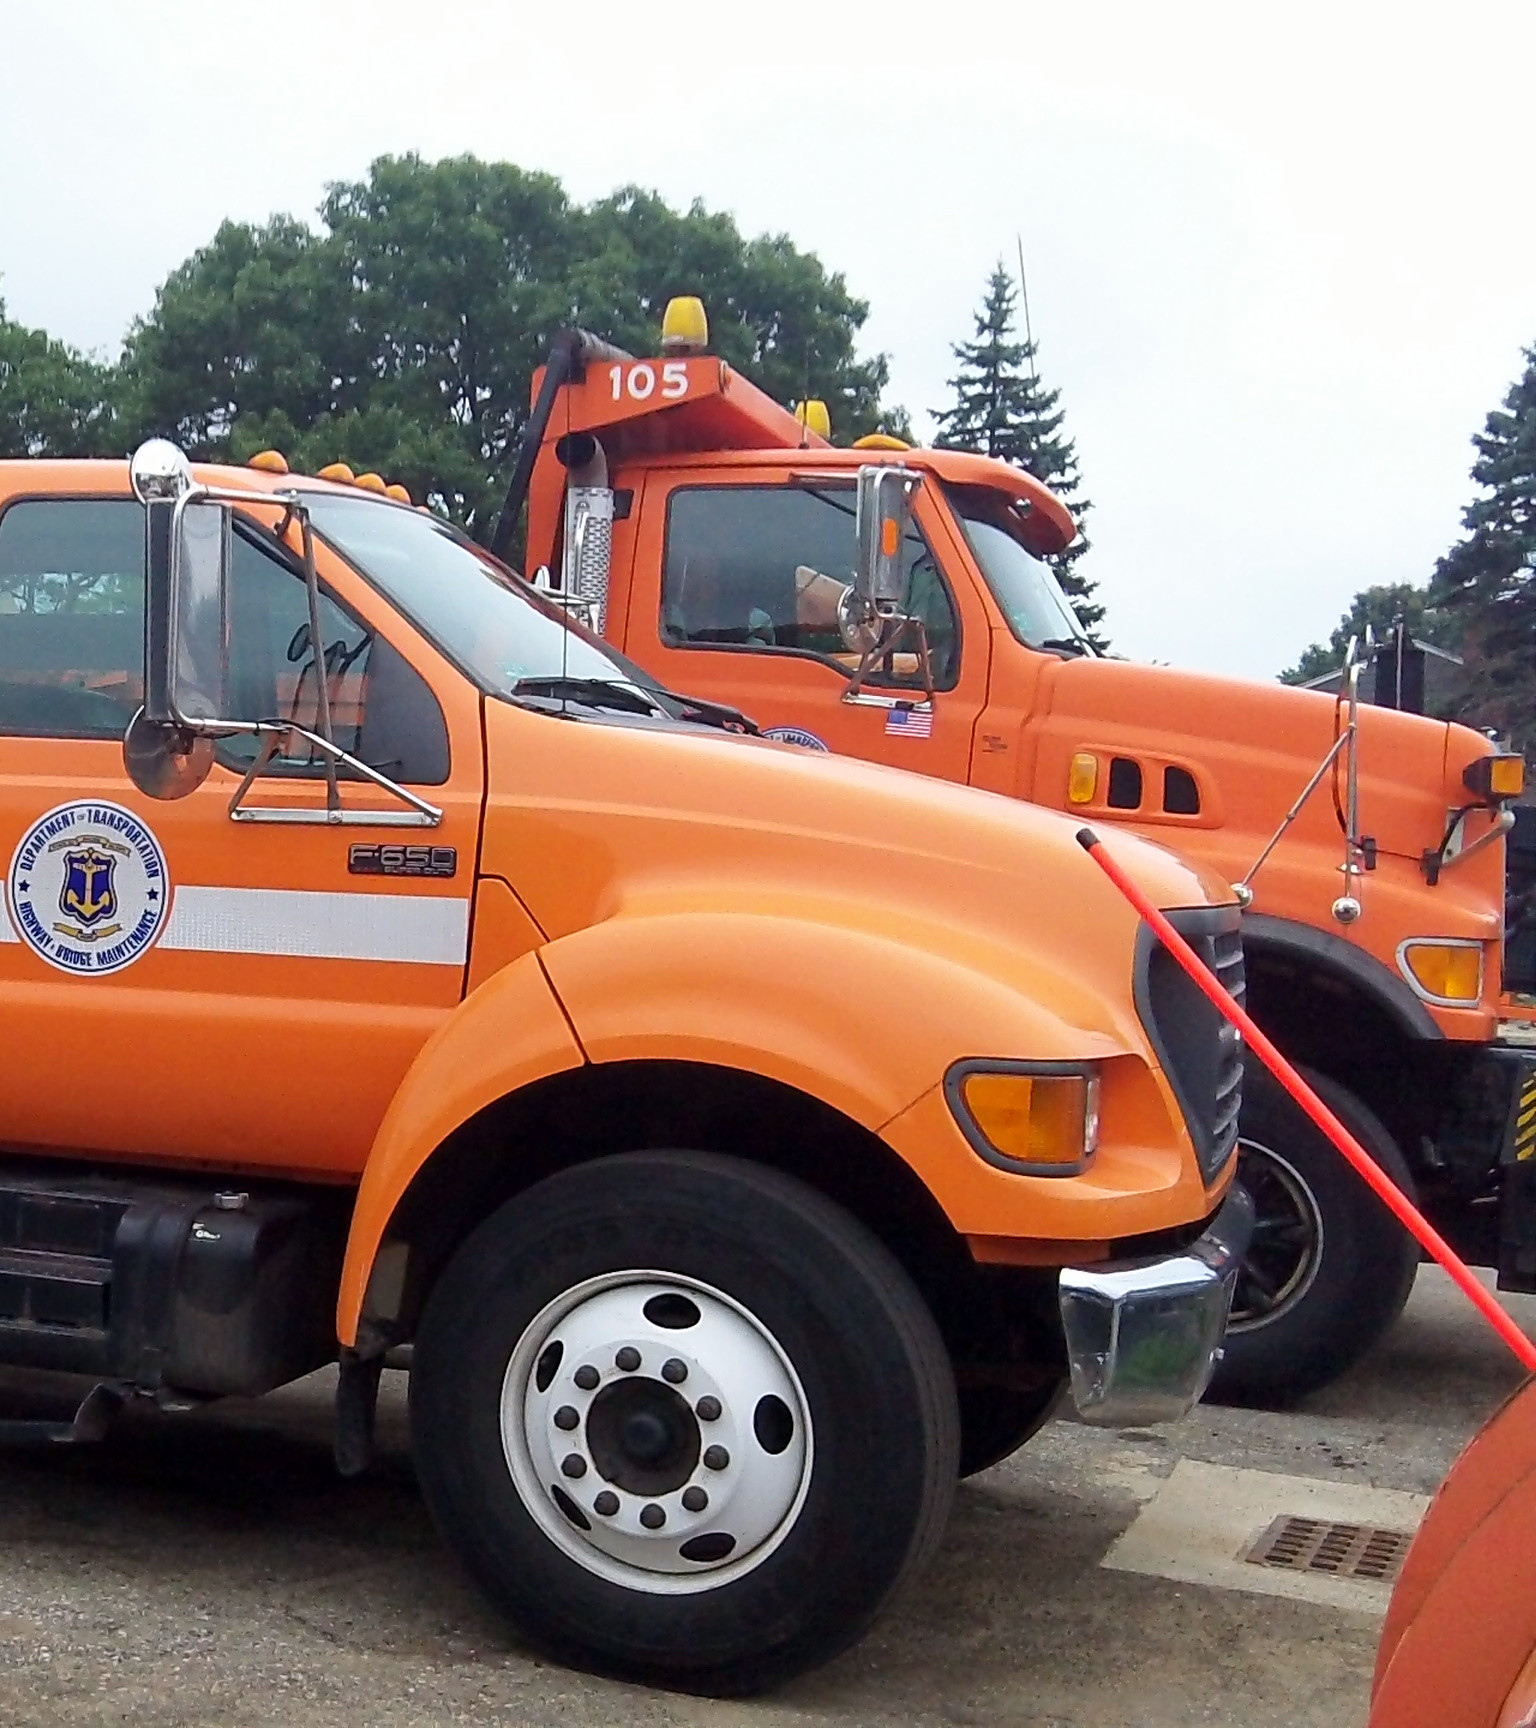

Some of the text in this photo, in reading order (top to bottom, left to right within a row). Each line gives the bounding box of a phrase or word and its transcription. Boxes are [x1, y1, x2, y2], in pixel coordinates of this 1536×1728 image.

[609, 363, 688, 401] 105
[20, 811, 75, 871] DEPARTMENT
[87, 809, 160, 879] TRANSPORTATION
[19, 901, 157, 966] HIGHWAY BRIDGE MAINTENANCE
